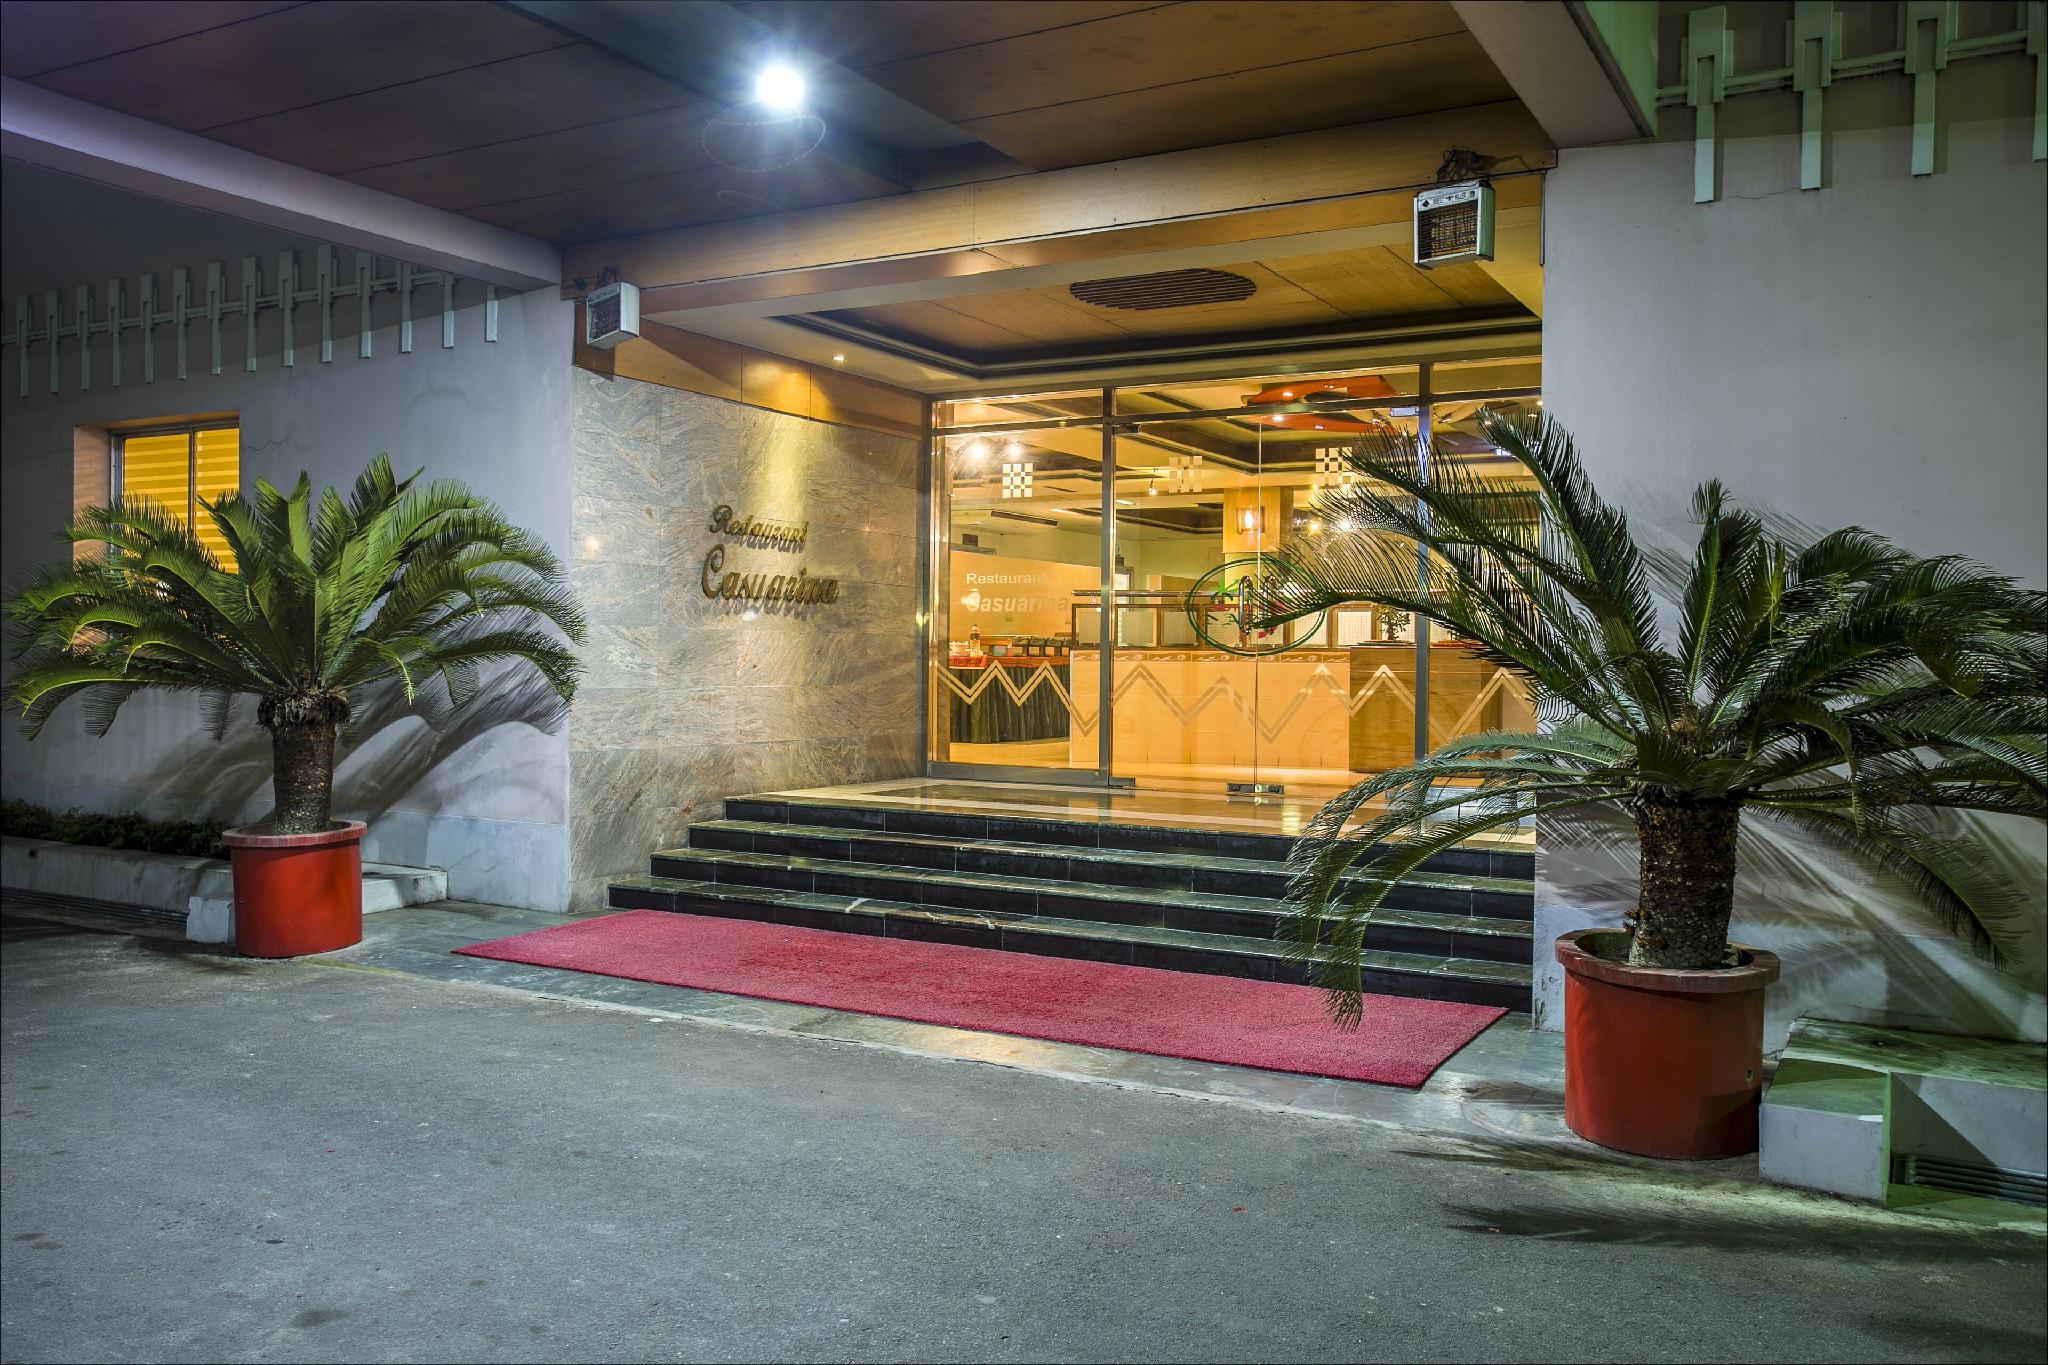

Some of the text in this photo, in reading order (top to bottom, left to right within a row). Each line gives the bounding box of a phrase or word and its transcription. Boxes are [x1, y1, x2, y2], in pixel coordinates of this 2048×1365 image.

[710, 505, 809, 543] Restaurant
[702, 544, 839, 604] Casuarina
[966, 573, 1047, 585] Restaurant
